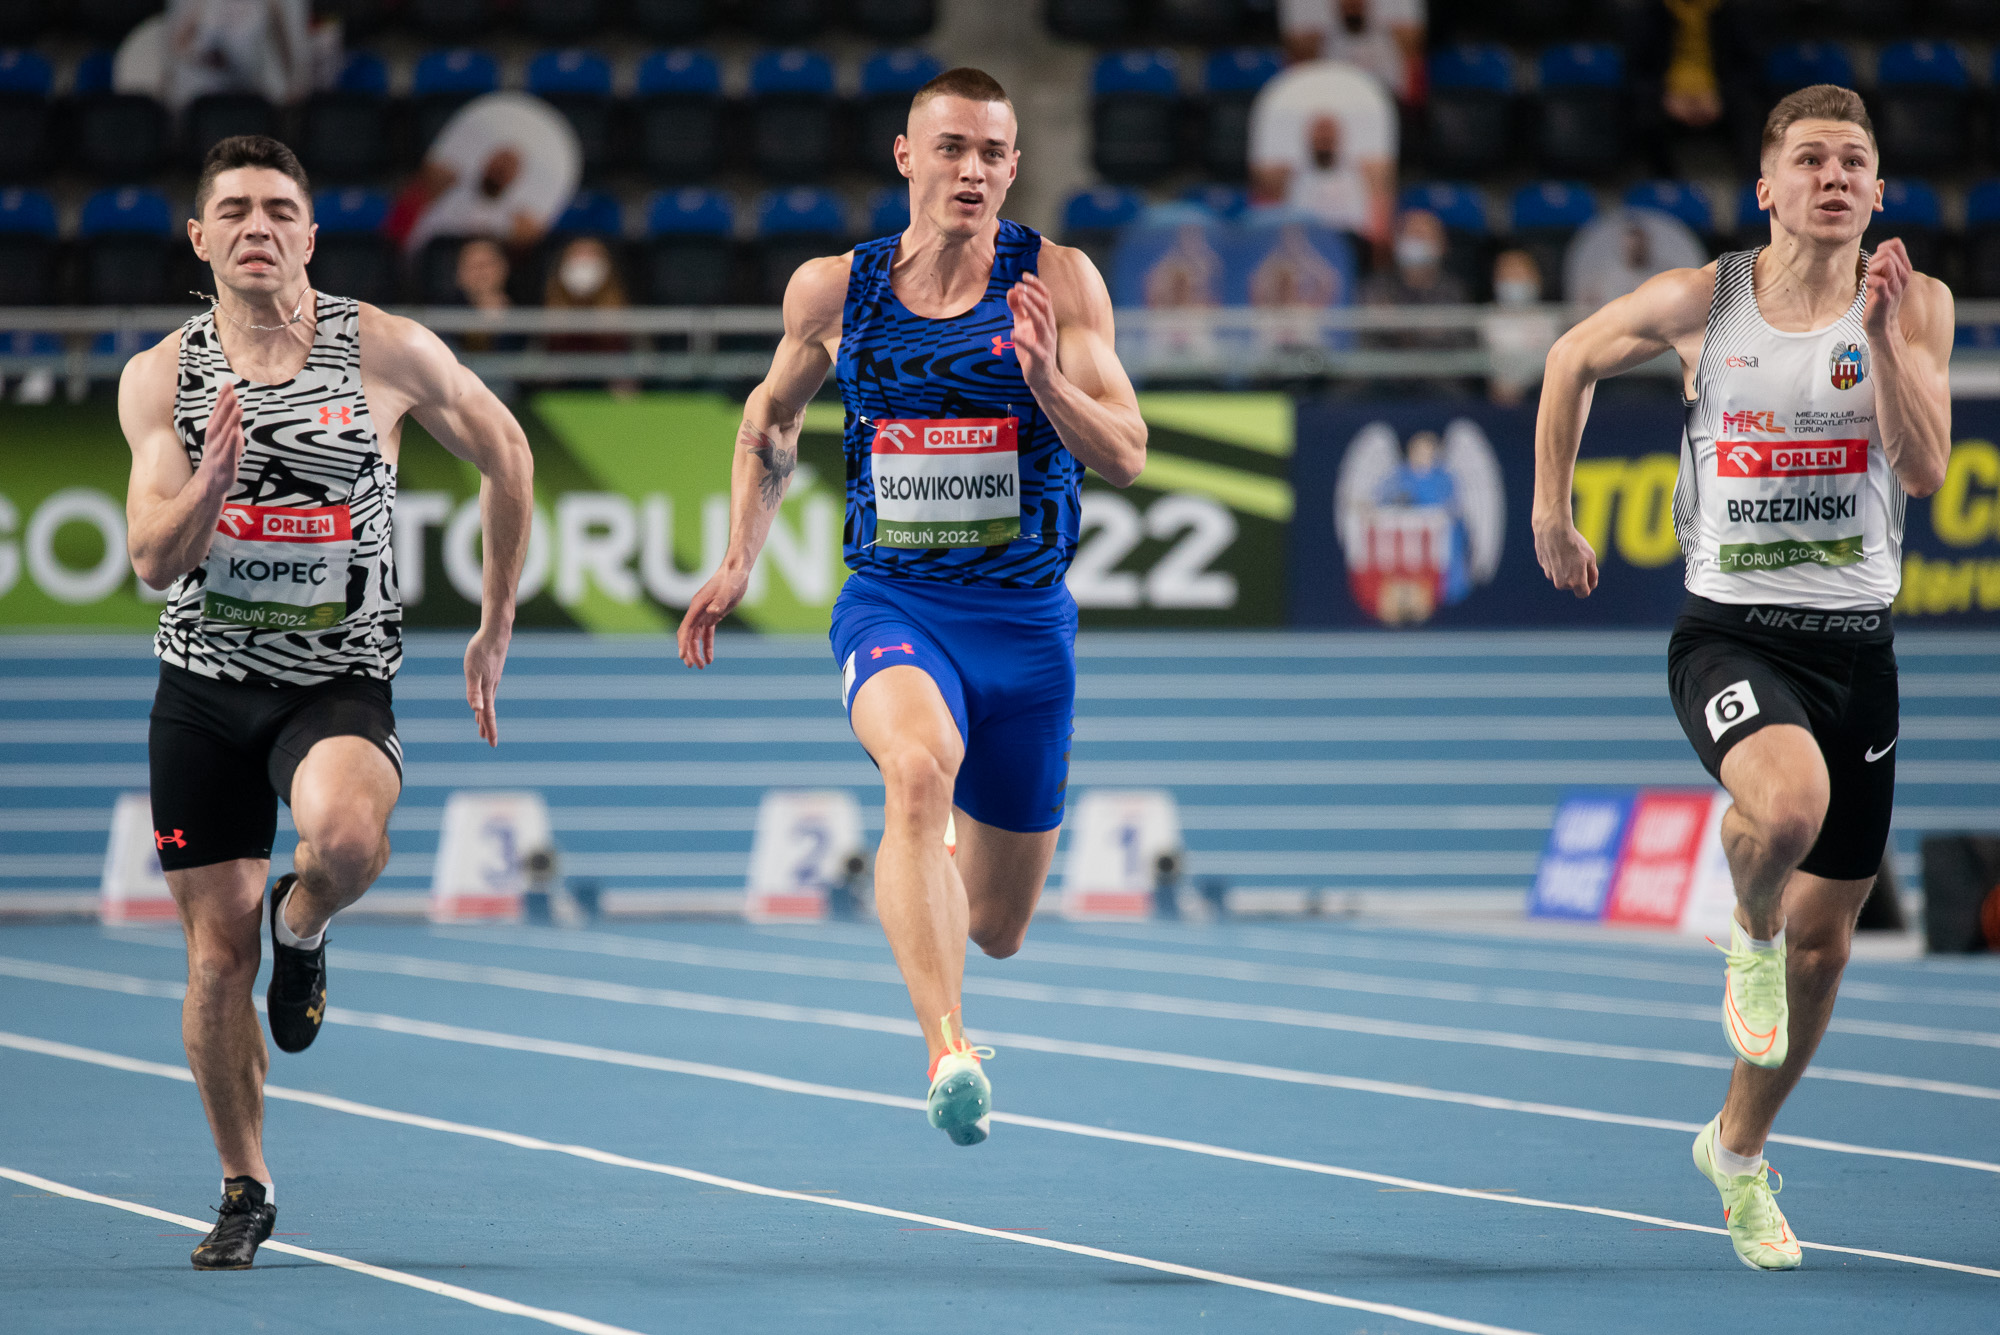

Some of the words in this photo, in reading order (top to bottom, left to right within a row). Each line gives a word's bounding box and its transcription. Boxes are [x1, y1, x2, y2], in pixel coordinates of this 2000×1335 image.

[1722, 410, 1786, 434] MKL
[1794, 415, 1874, 426] LEKKOATLETYCZNY
[1830, 410, 1854, 418] KLUB
[928, 429, 993, 446] ORLEN
[1776, 450, 1842, 467] ORLEN
[880, 474, 1014, 500] SŁOWIKOWSKI
[1727, 491, 1856, 523] BRZEZIŃSKI
[267, 517, 330, 534] ORLEN
[886, 528, 933, 544] TORUŃ
[938, 530, 980, 544] 2022
[1730, 549, 1785, 566] TORUŃ
[1789, 548, 1829, 562] 2022
[229, 557, 328, 586] KOPEĆ
[215, 602, 265, 623] TORUŃ
[1745, 607, 1824, 631] NIKE
[1824, 615, 1881, 632] PRO
[1715, 691, 1745, 724] 6
[788, 817, 831, 881] 2
